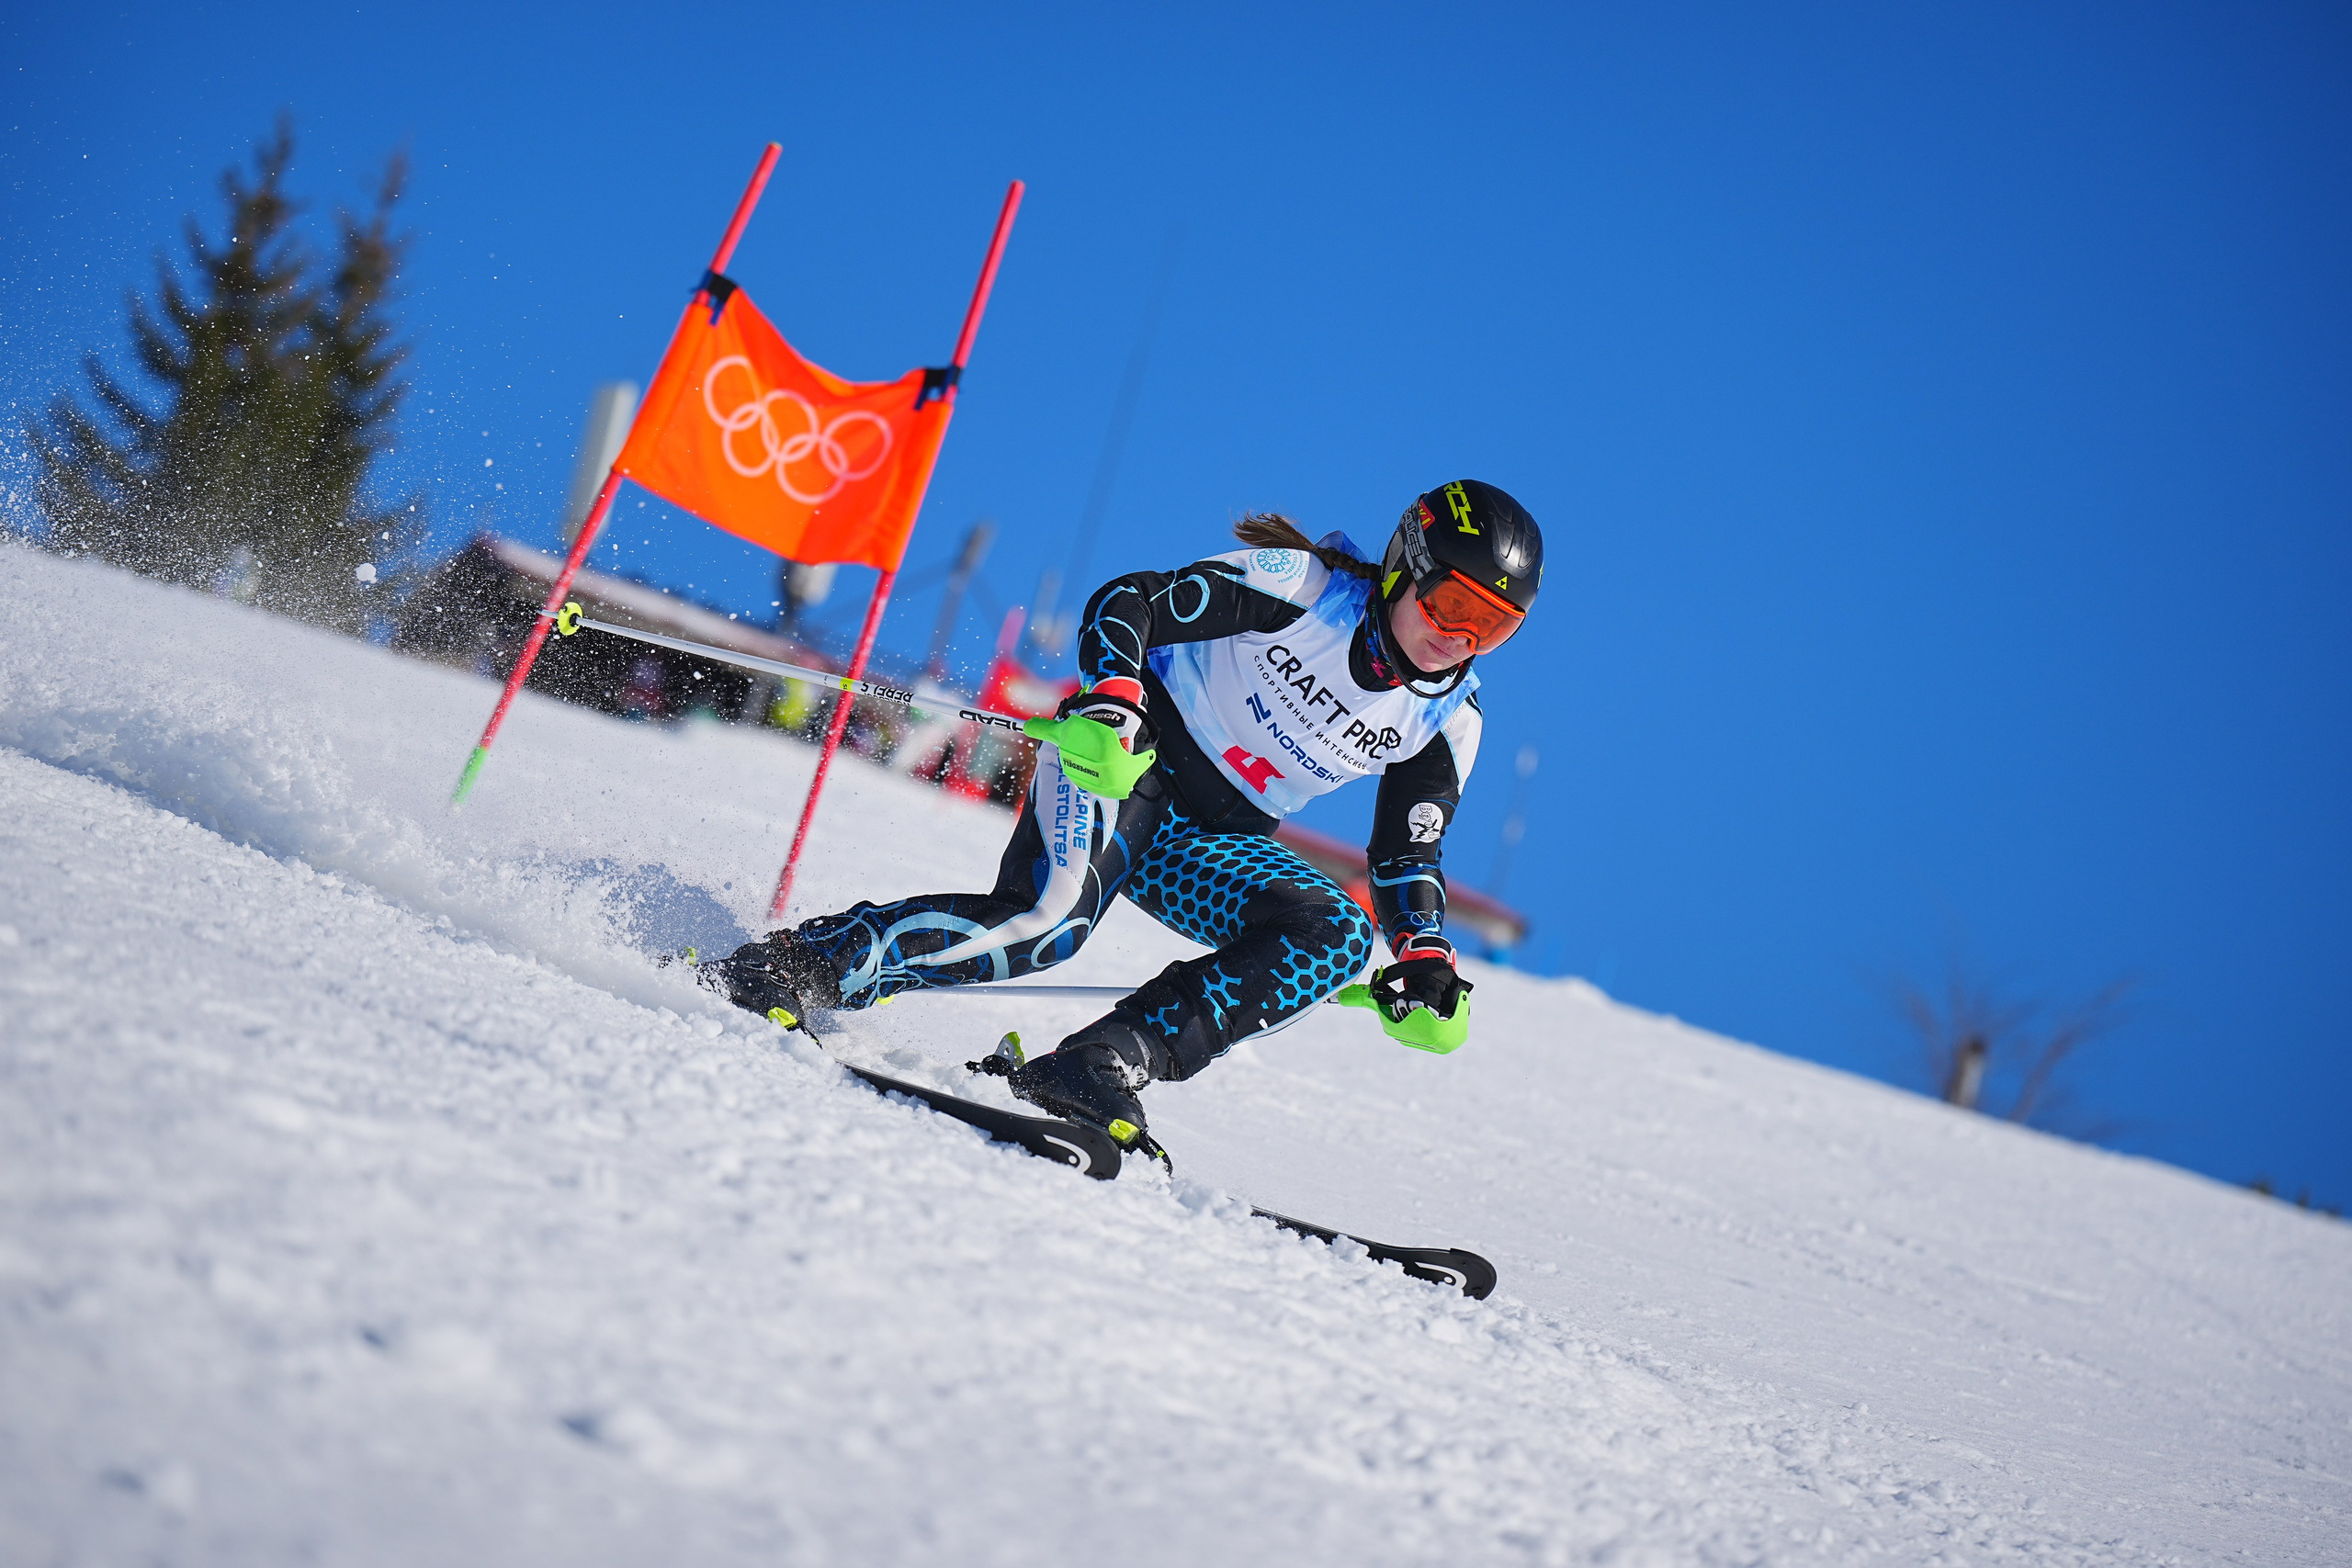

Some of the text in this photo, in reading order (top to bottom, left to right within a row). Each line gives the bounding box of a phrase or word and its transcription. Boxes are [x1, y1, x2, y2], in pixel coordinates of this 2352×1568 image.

[1254, 655, 1314, 730] СПОРТИВНЫЕ
[1266, 645, 1389, 760] CRAFT PRO
[1063, 759, 1099, 778] KOMPERDELL
[1267, 723, 1343, 783] NORDSKI
[1054, 784, 1069, 868] STOLITSA
